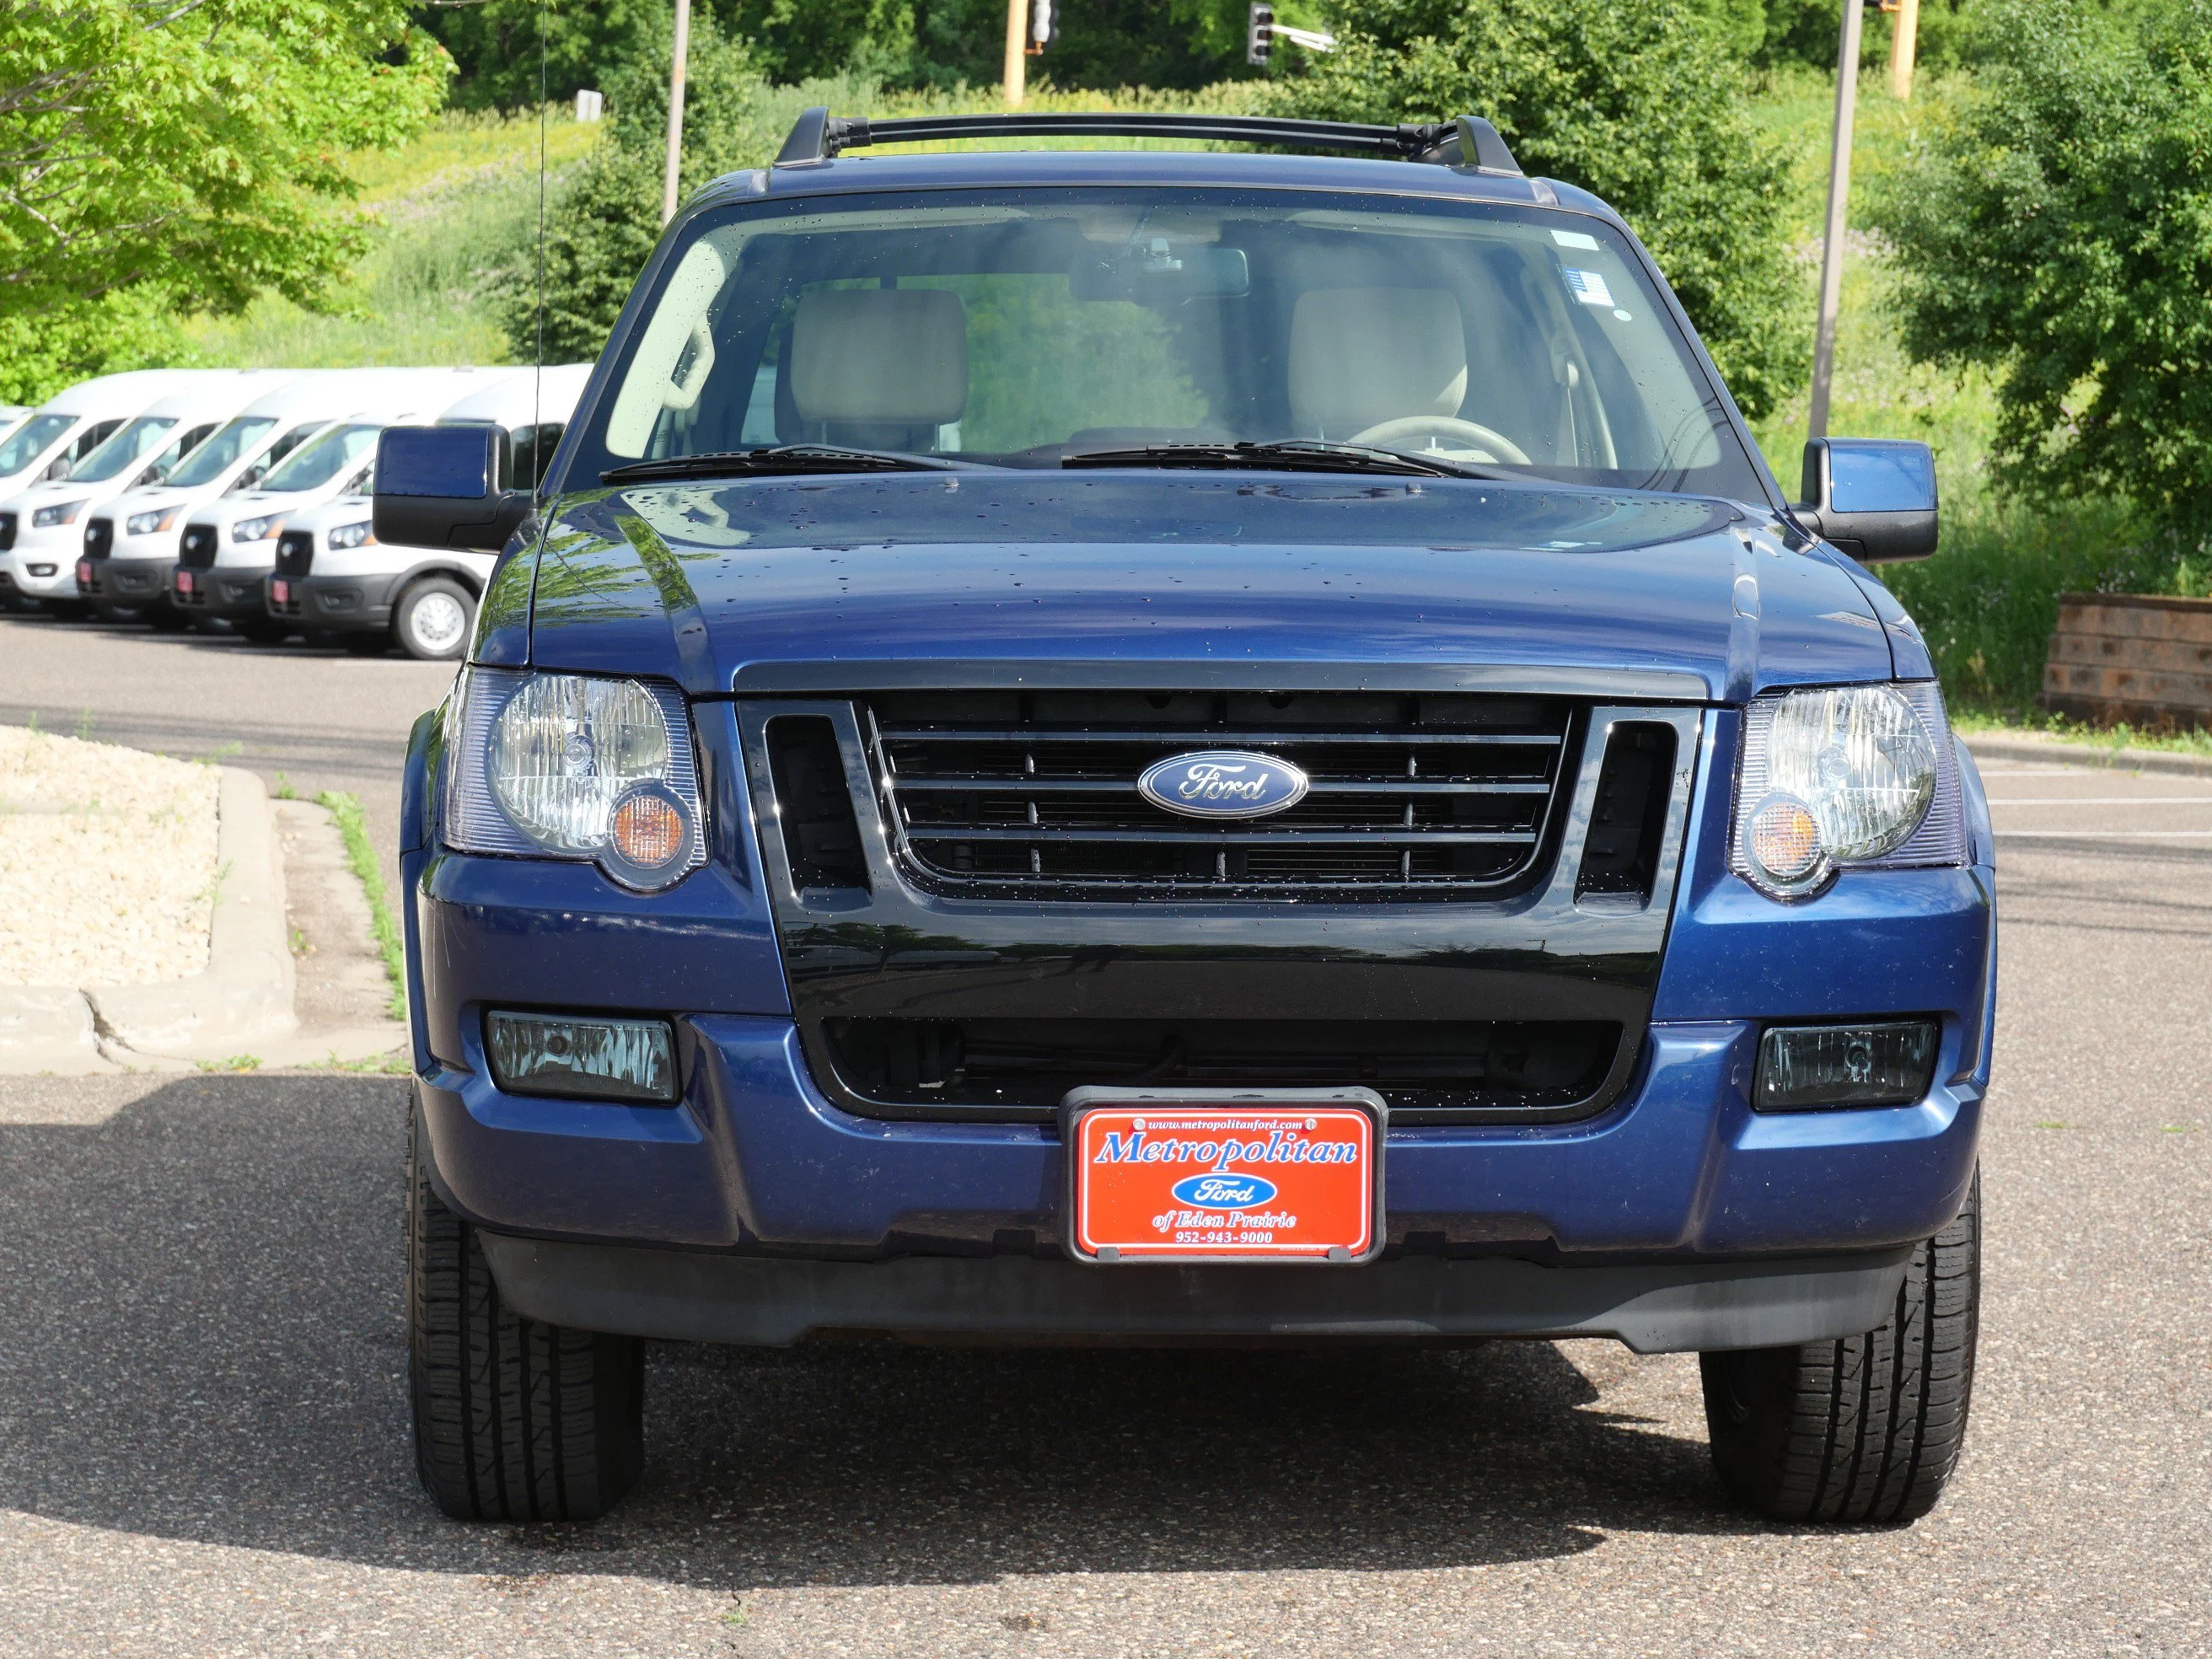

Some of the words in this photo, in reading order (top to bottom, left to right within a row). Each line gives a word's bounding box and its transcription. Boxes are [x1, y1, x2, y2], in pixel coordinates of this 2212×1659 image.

[1179, 763, 1269, 800] Ford
[1148, 1119, 1302, 1132] www.metropolitanford.com
[1093, 1130, 1358, 1173] Metropolitan
[1194, 1178, 1255, 1202] Ford
[1152, 1210, 1177, 1233] of
[1175, 1211, 1225, 1228] Eden
[1226, 1211, 1297, 1228] Prairie
[1175, 1232, 1273, 1243] 952-943-9000
